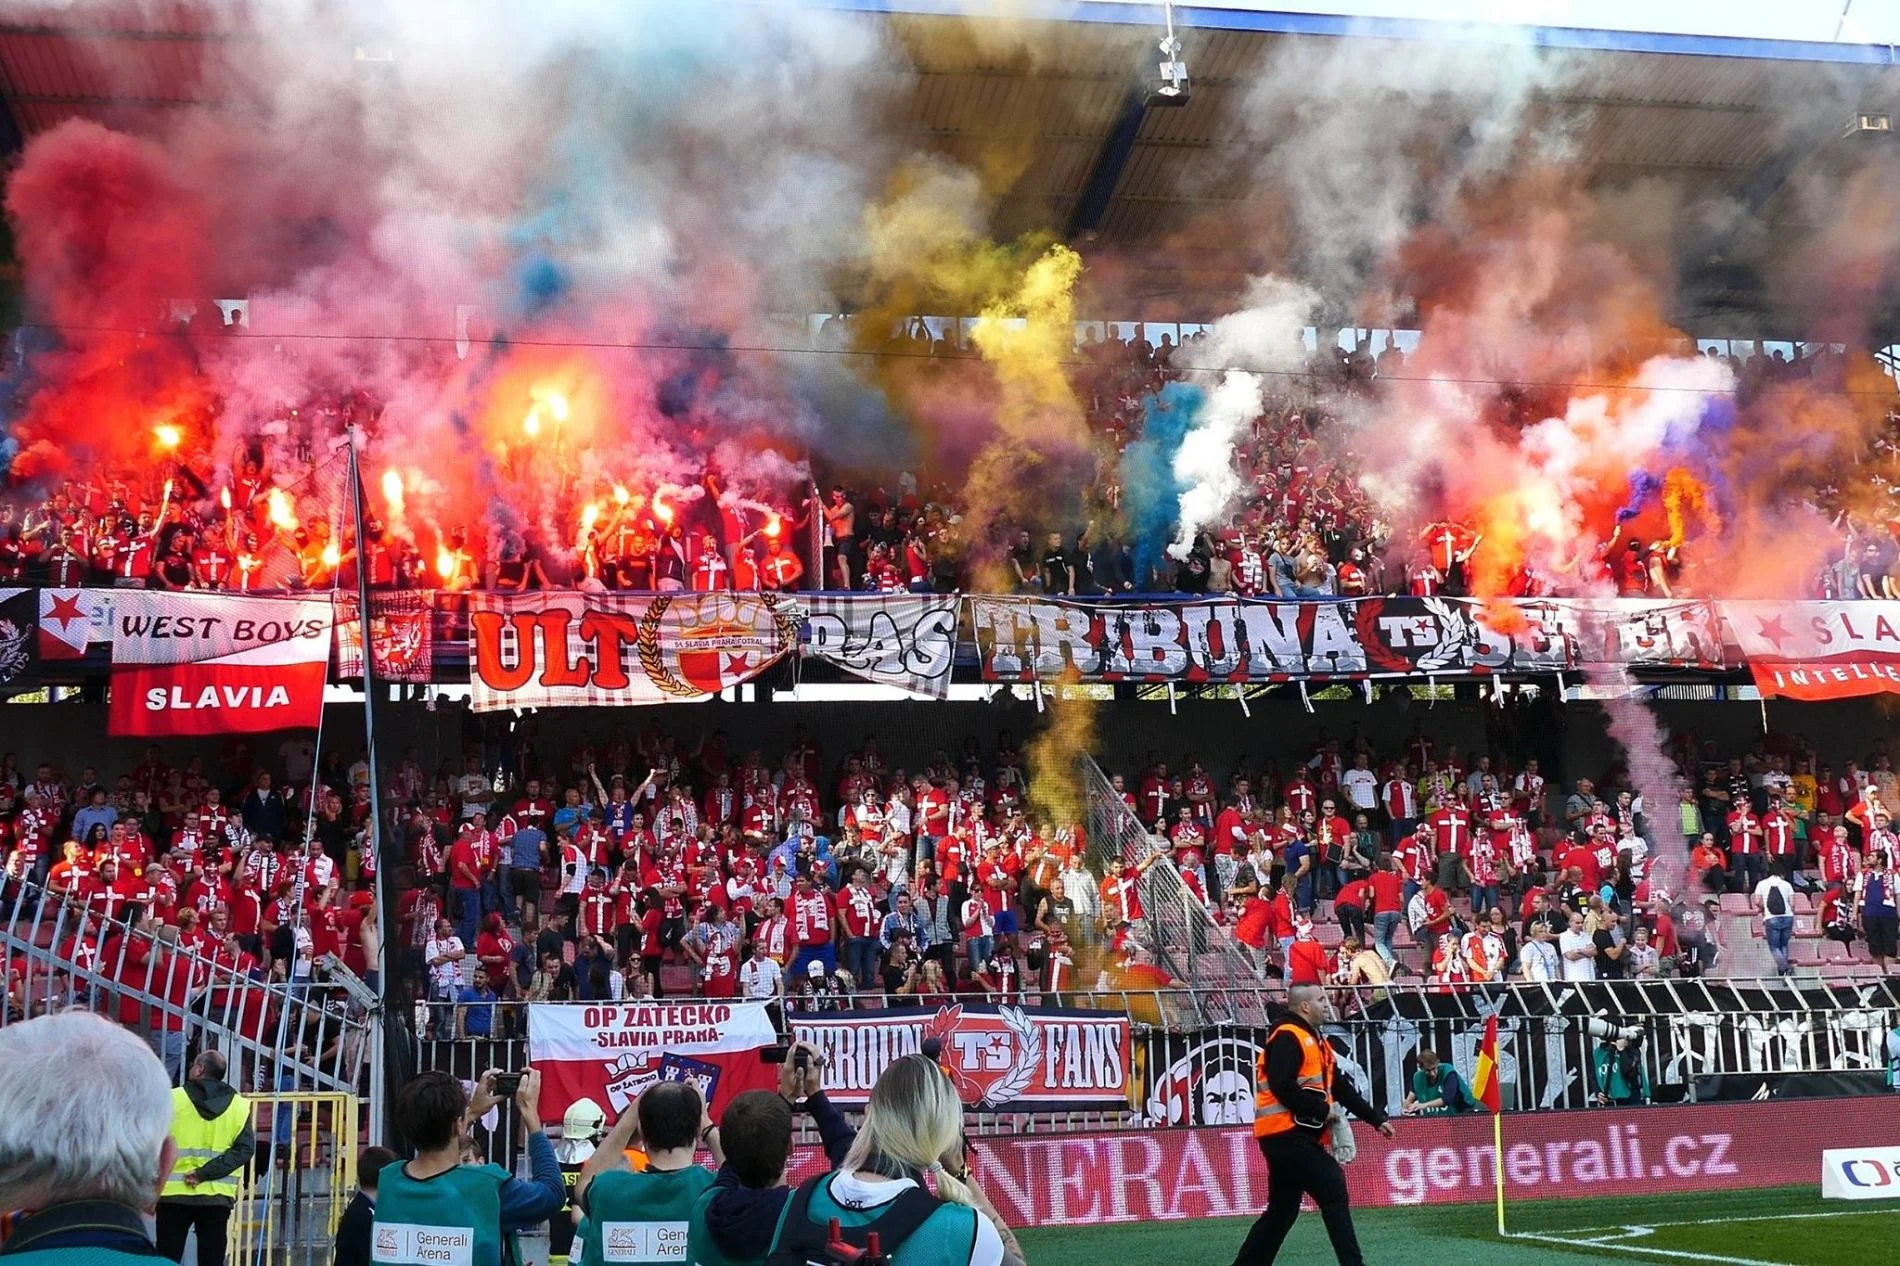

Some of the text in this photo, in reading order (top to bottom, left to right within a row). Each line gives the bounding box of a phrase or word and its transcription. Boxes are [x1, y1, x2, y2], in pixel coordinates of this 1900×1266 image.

[123, 615, 324, 642] WEST BOYS
[976, 603, 1367, 674] TRIBUNA
[1379, 616, 1438, 647] TS
[1811, 612, 1900, 644] SLA
[686, 638, 710, 648] SLAVIA
[145, 685, 290, 711] SLAVIA
[584, 1005, 731, 1028] OP ZATECKO
[954, 1032, 1010, 1070] TS
[1044, 1024, 1122, 1089] FANS
[1385, 1124, 1738, 1205] generali.cz
[416, 1231, 468, 1247] Generali
[416, 1246, 451, 1260] Arena
